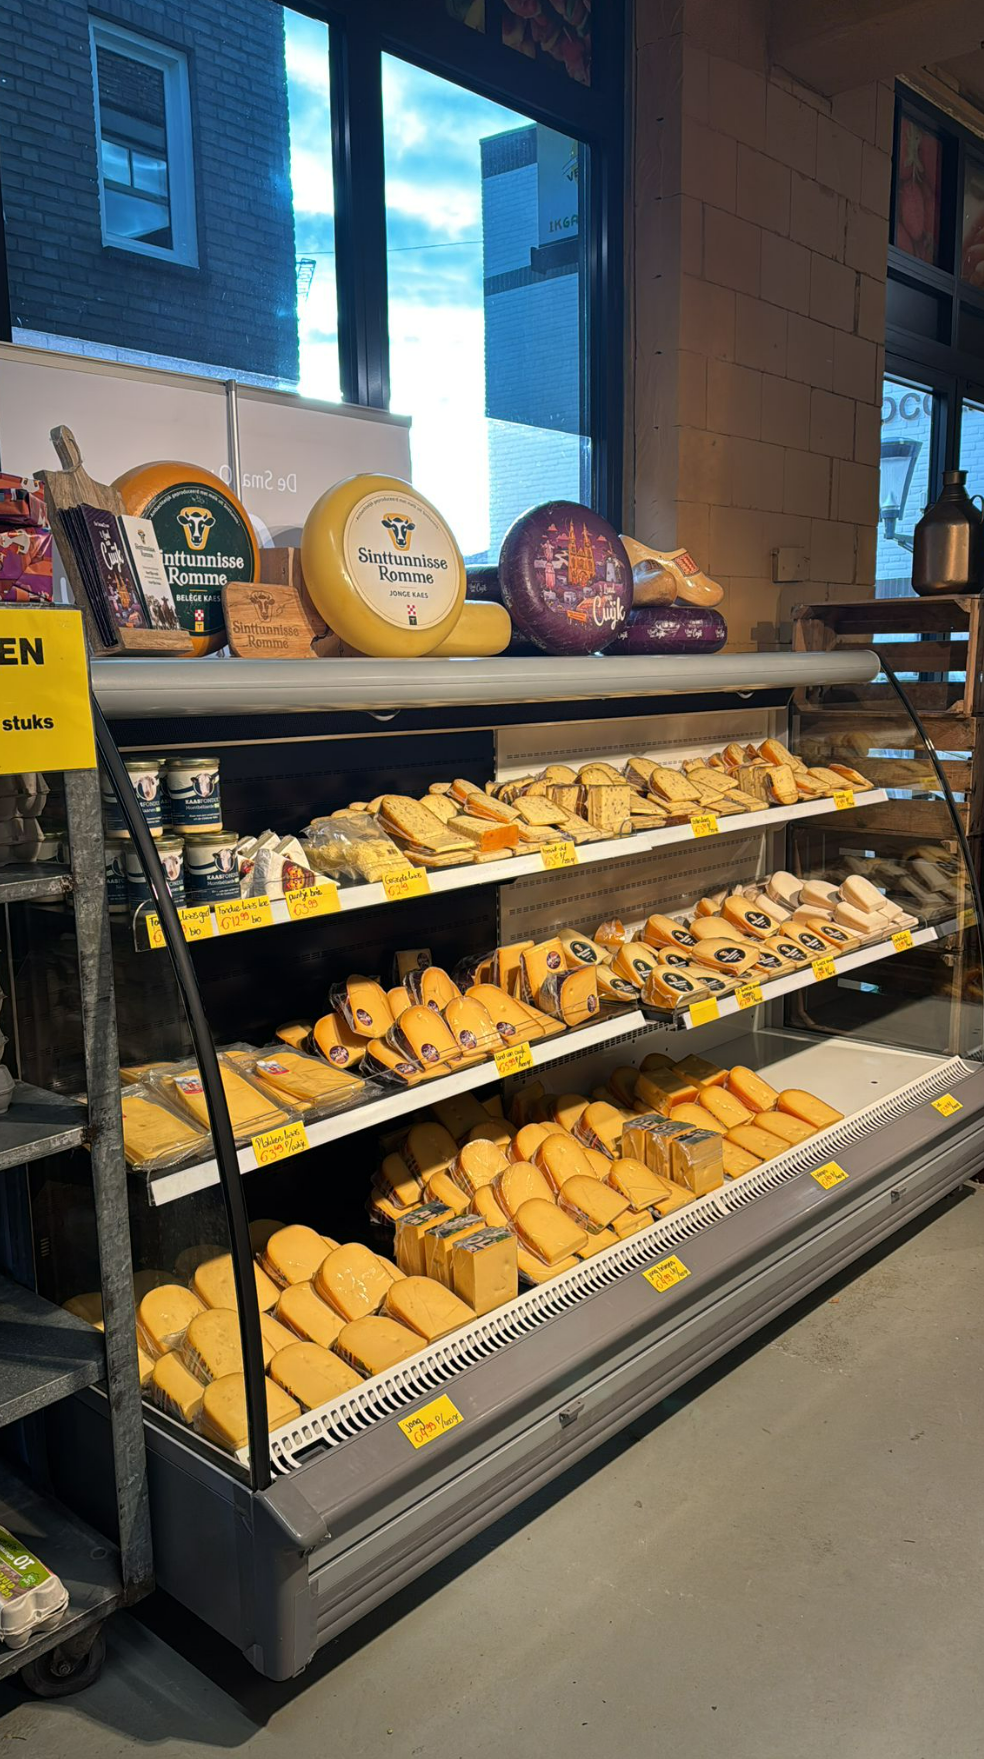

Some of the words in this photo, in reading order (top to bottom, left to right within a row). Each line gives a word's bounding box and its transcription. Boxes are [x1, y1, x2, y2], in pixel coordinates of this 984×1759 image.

[160, 549, 244, 569] inttunnisse
[358, 547, 448, 570] Sinttunnisse
[168, 566, 228, 586] Romme
[378, 565, 434, 585] Romme
[176, 592, 202, 602] BELÈGE
[203, 594, 221, 603] KAES
[389, 590, 411, 598] JONGE
[412, 591, 429, 599] KAES
[232, 620, 299, 637] Sinttunnisse
[248, 635, 289, 649] Romme
[0, 637, 44, 665] EN
[2, 714, 54, 731] stuks
[217, 904, 240, 915] Fondue
[251, 915, 262, 924] bio
[189, 927, 202, 937] bio
[403, 1418, 426, 1434] jong
[13, 1555, 35, 1571] 10
